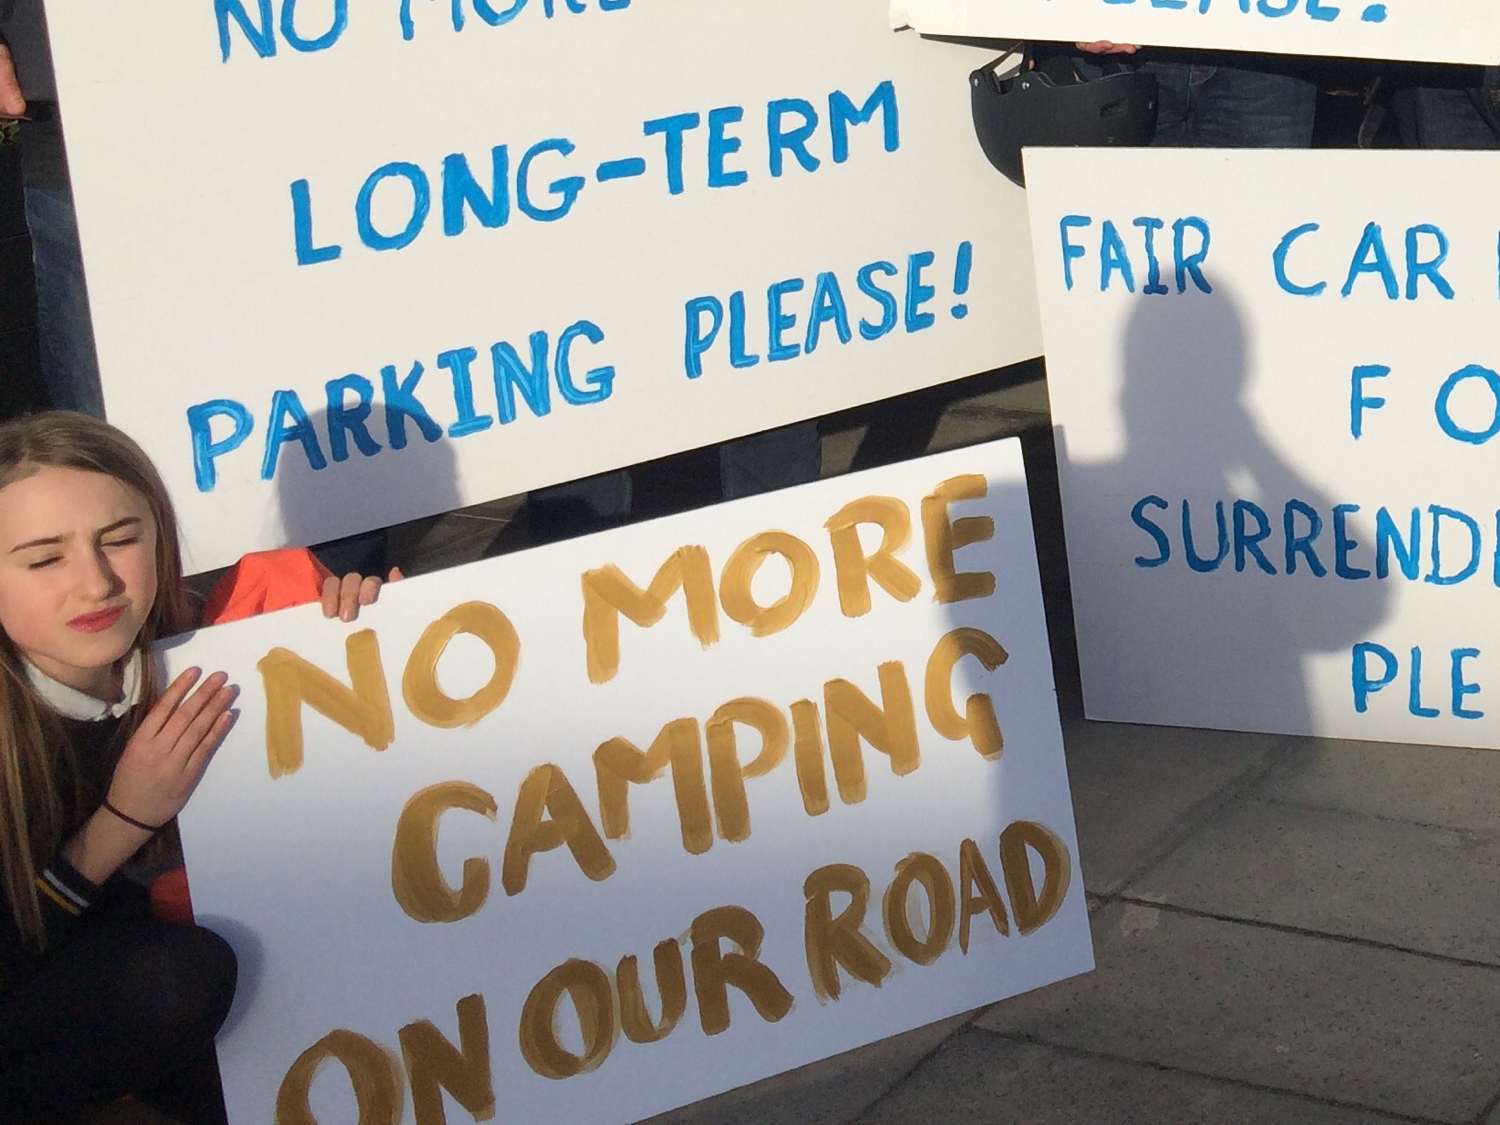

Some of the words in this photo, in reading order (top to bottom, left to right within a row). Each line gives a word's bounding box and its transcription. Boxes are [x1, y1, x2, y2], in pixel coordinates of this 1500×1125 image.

[291, 81, 899, 266] LONG-TERM
[1060, 216, 1212, 295] FAIR
[1273, 223, 1454, 299] CAR
[187, 321, 614, 491] PARKING
[685, 242, 971, 378] PLEASE!
[257, 601, 520, 779] NO
[582, 474, 996, 684] MORE
[391, 627, 1008, 923] CAMPING
[276, 995, 493, 1125] ON
[520, 907, 792, 1078] OUR
[805, 822, 1068, 997] ROAD
